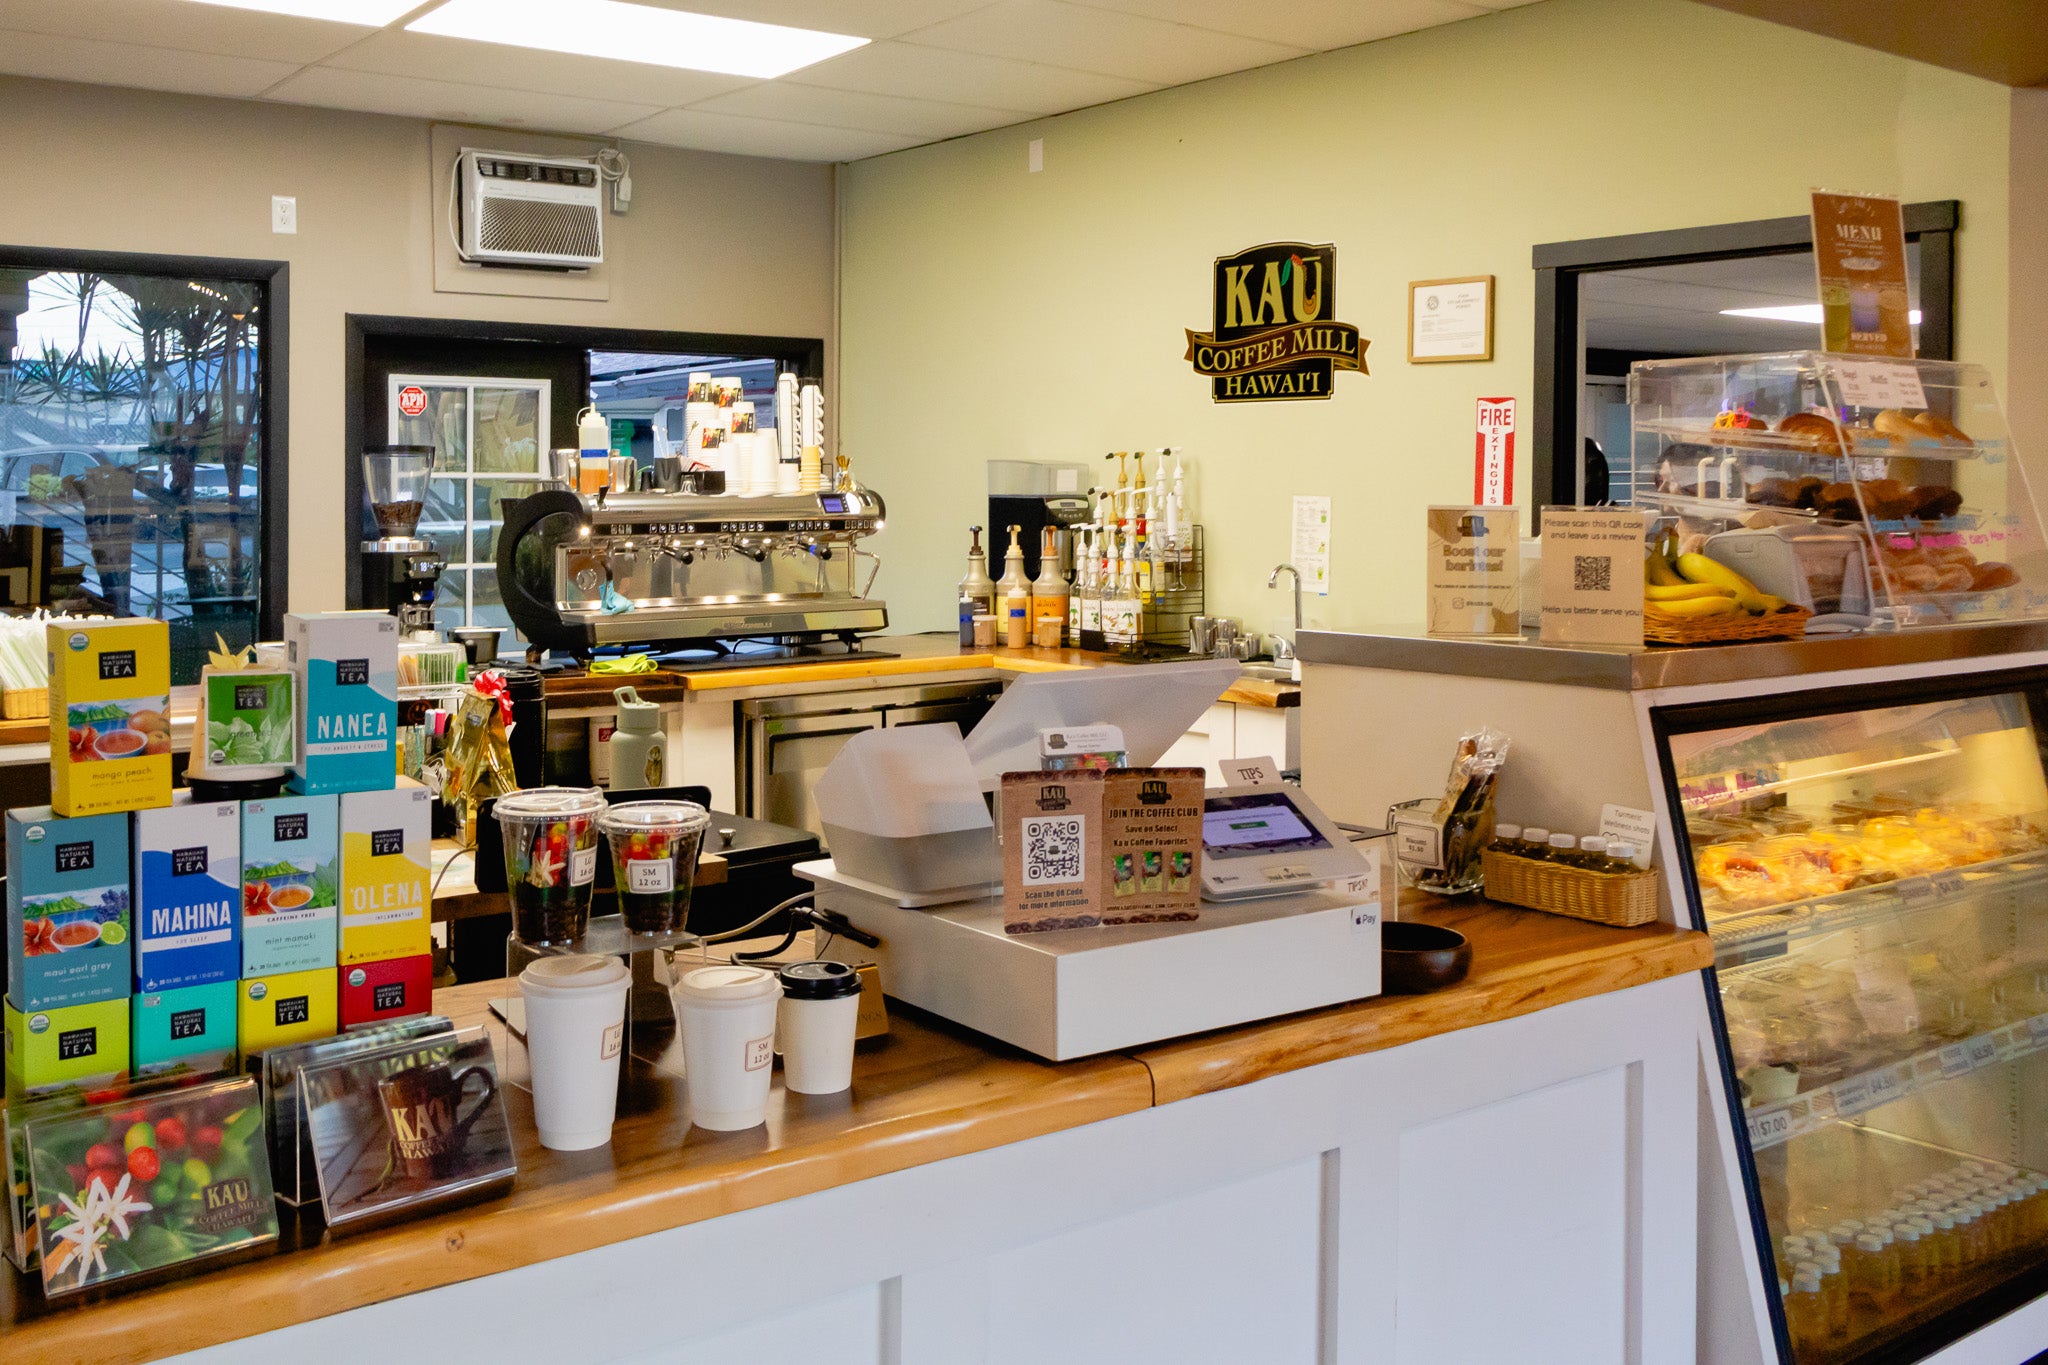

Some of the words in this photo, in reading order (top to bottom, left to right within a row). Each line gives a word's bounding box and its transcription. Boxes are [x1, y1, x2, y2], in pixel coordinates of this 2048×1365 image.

[1836, 224, 1882, 241] MENU
[1197, 336, 1286, 371] COFFEE
[1291, 326, 1356, 354] MILL
[402, 392, 424, 406] APN
[1480, 408, 1512, 426] FIRE
[1544, 518, 1570, 528] Please
[1572, 520, 1590, 528] scan
[1592, 519, 1607, 528] this
[1608, 520, 1621, 529] QR
[1623, 520, 1644, 529] code
[1568, 532, 1589, 540] leave
[1542, 606, 1560, 614] Help
[1574, 606, 1598, 614] better
[1600, 608, 1622, 616] serve
[102, 666, 133, 676] TEA
[340, 673, 366, 683] TEA
[238, 698, 264, 707] TEA
[317, 712, 388, 740] NANEA
[92, 771, 122, 780] mango
[126, 767, 152, 777] peach
[1237, 766, 1264, 780] TIPS
[1109, 809, 1127, 819] JOIN
[1130, 808, 1145, 818] THE
[1146, 808, 1176, 818] COFFEE
[1177, 807, 1198, 817] CLUB
[1615, 810, 1642, 822] Turmeric
[1125, 824, 1143, 833] Save
[1154, 824, 1178, 833] Select
[1604, 820, 1632, 830] Wellness
[1632, 826, 1650, 834] shots
[278, 828, 305, 838] TEA
[1130, 838, 1153, 847] Coffee
[1155, 837, 1188, 846] Favorites
[375, 843, 400, 853] TEA
[60, 850, 89, 858] NATURAL
[60, 856, 90, 868] TEA
[176, 862, 204, 873] TEA
[642, 868, 656, 876] SM
[1024, 891, 1042, 900] Scan
[1044, 890, 1054, 898] the
[1056, 889, 1065, 898] QR
[1066, 888, 1083, 896] Code
[1018, 902, 1029, 910] for
[1030, 901, 1048, 910] more
[1050, 898, 1089, 908] information
[151, 900, 232, 935] MAHINA
[267, 914, 298, 922] CAFFEINE
[1362, 914, 1376, 925] Pay
[265, 937, 282, 945] mint
[285, 932, 316, 943] mamaki
[44, 967, 66, 978] maui
[69, 964, 88, 974] earl
[90, 962, 112, 973] grey
[377, 996, 402, 1008] TEA
[278, 1004, 305, 1012] NATURAL
[280, 1010, 305, 1022] TEA
[174, 1018, 201, 1026] NATURAL
[174, 1023, 202, 1036] TEA
[62, 1037, 92, 1046] NATURAL
[609, 1042, 616, 1052] 16
[758, 1042, 768, 1052] SM
[63, 1043, 93, 1056] TEA
[754, 1055, 763, 1064] 12
[1760, 1116, 1787, 1136] $7.00
